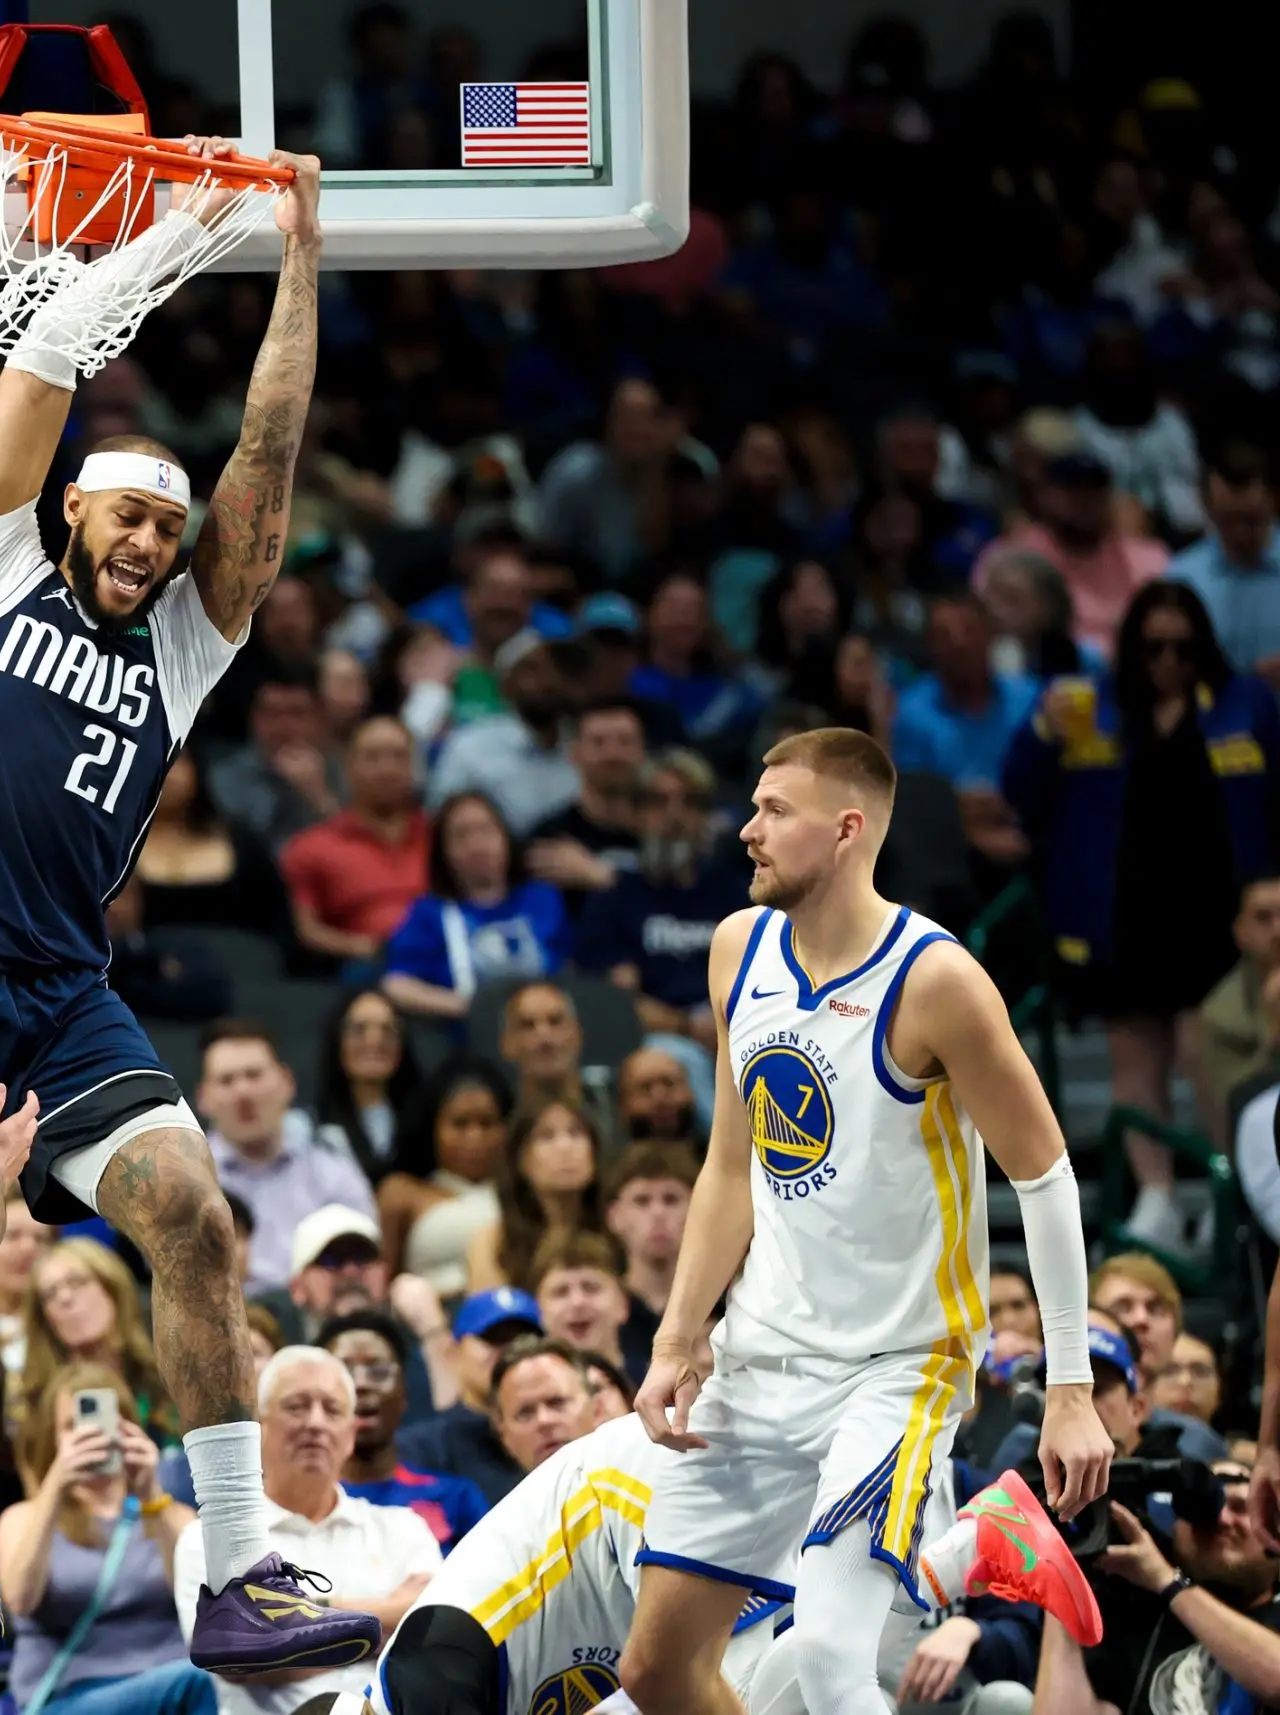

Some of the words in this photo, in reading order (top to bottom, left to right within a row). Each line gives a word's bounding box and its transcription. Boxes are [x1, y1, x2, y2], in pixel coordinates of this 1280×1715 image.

[64, 724, 138, 814] 21
[829, 999, 871, 1017] Rakuten
[740, 1031, 800, 1062] GOLDEN
[804, 1039, 839, 1085] STATE
[796, 1084, 814, 1119] 7
[764, 1161, 838, 1200] RRIORS
